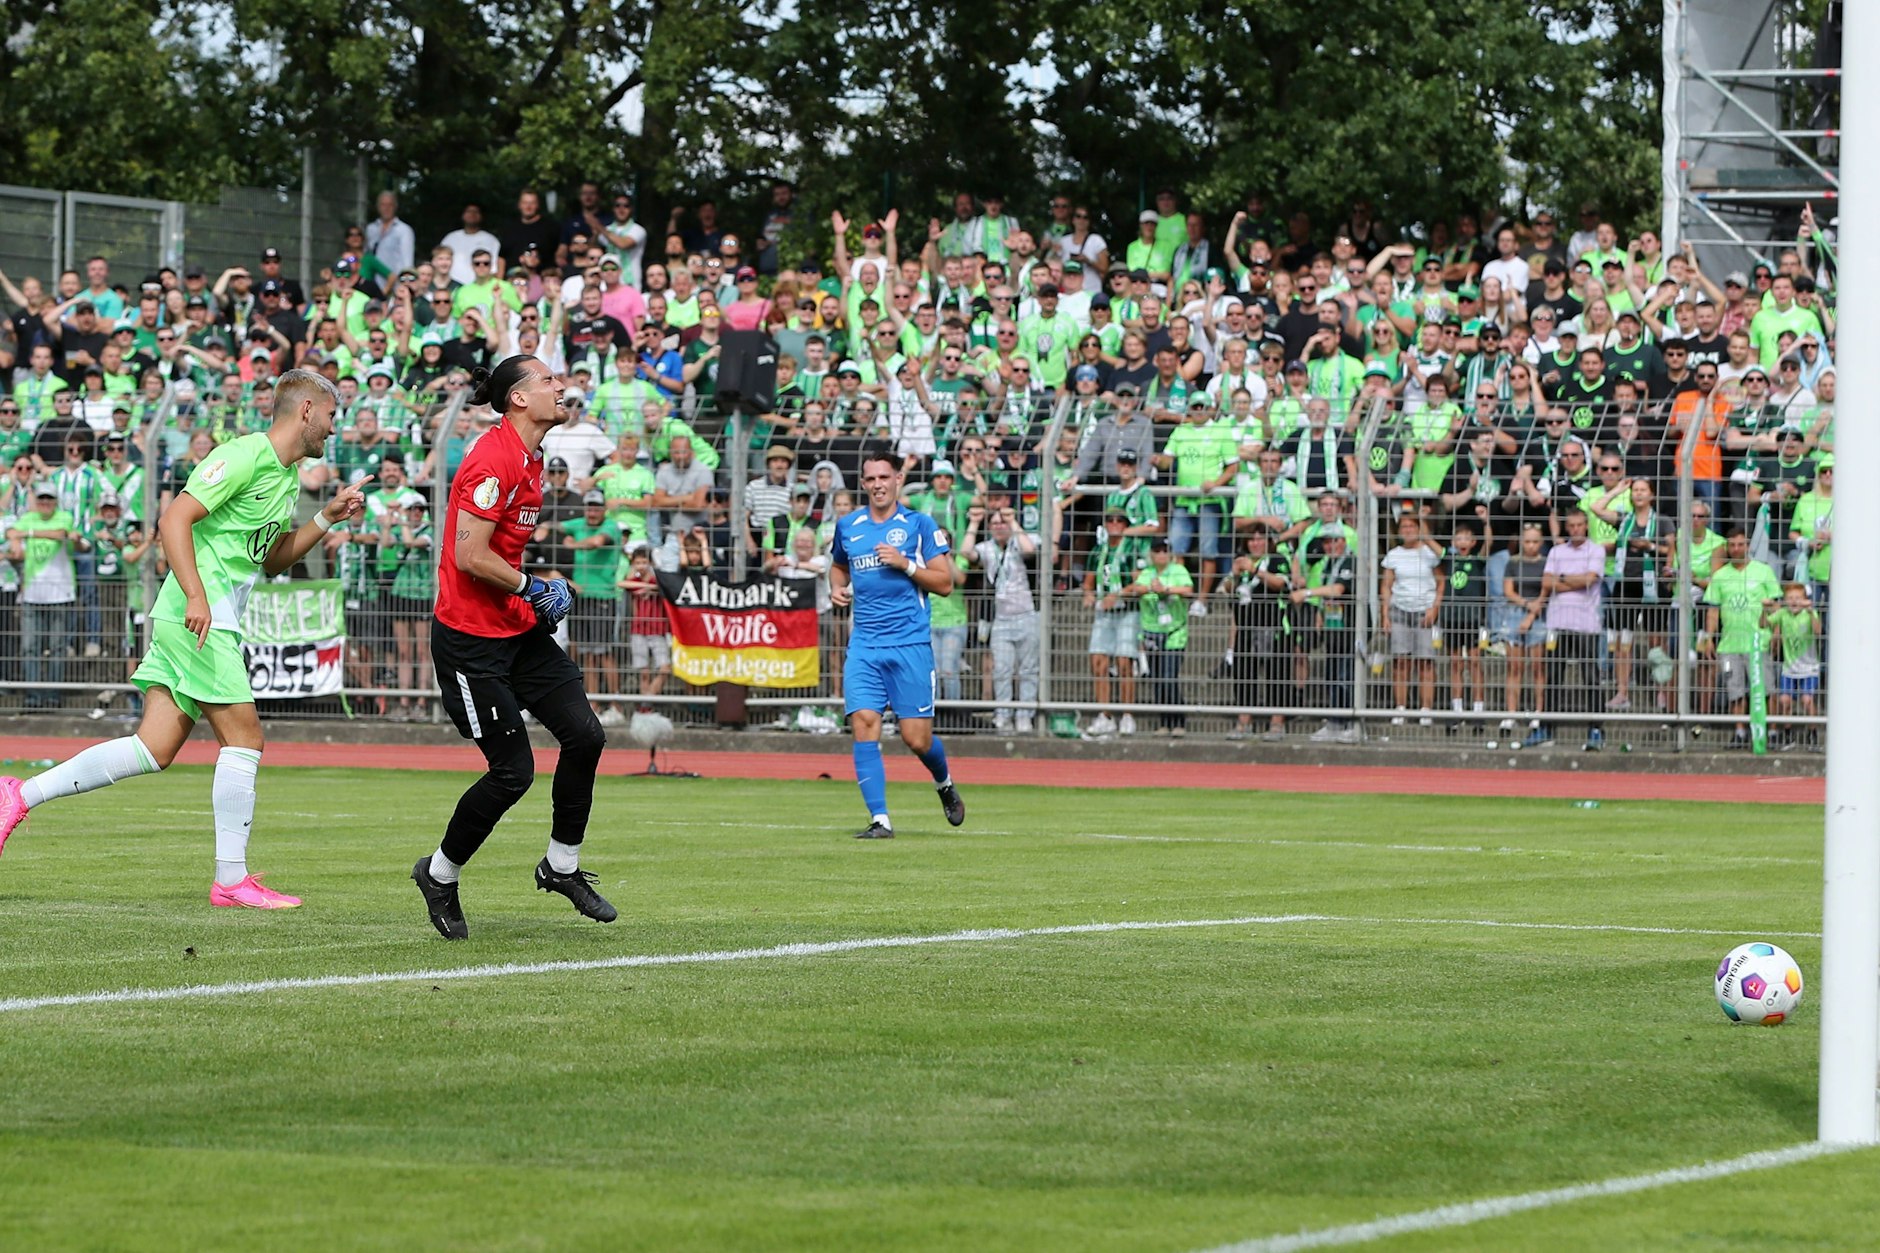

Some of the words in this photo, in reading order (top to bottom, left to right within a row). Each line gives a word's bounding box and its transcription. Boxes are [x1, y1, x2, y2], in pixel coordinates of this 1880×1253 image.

[675, 575, 799, 608] Altmark-
[702, 612, 778, 646] Wölfe
[491, 706, 499, 720] 1
[1722, 954, 1748, 997] DERBYSTAR
